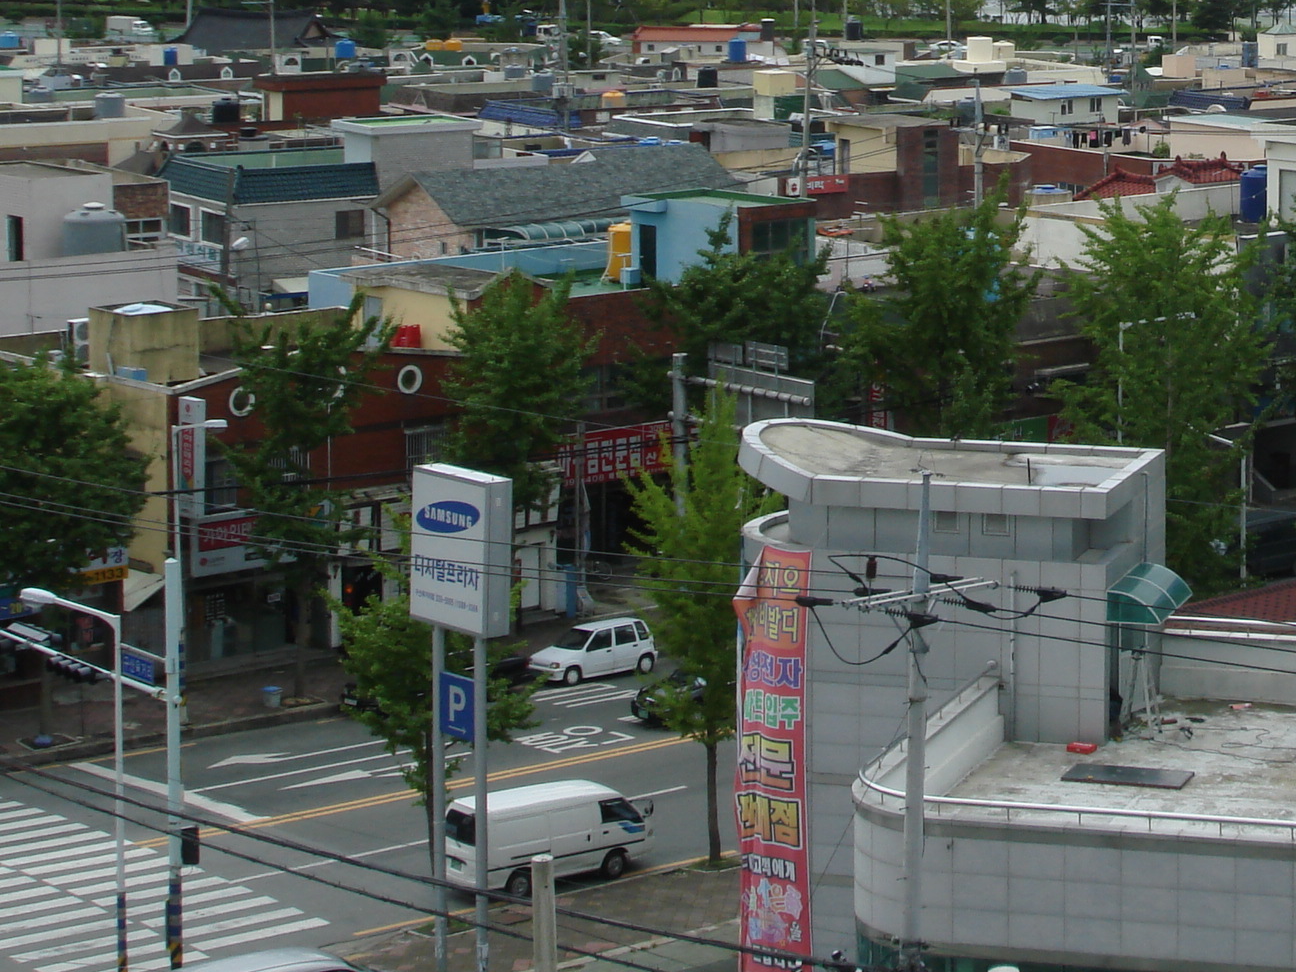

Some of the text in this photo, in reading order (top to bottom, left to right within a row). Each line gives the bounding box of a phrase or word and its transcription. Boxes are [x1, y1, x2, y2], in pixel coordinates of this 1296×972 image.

[424, 504, 473, 529] SAMSUNG
[414, 553, 480, 591] 디지털프라자
[448, 685, 467, 721] P
